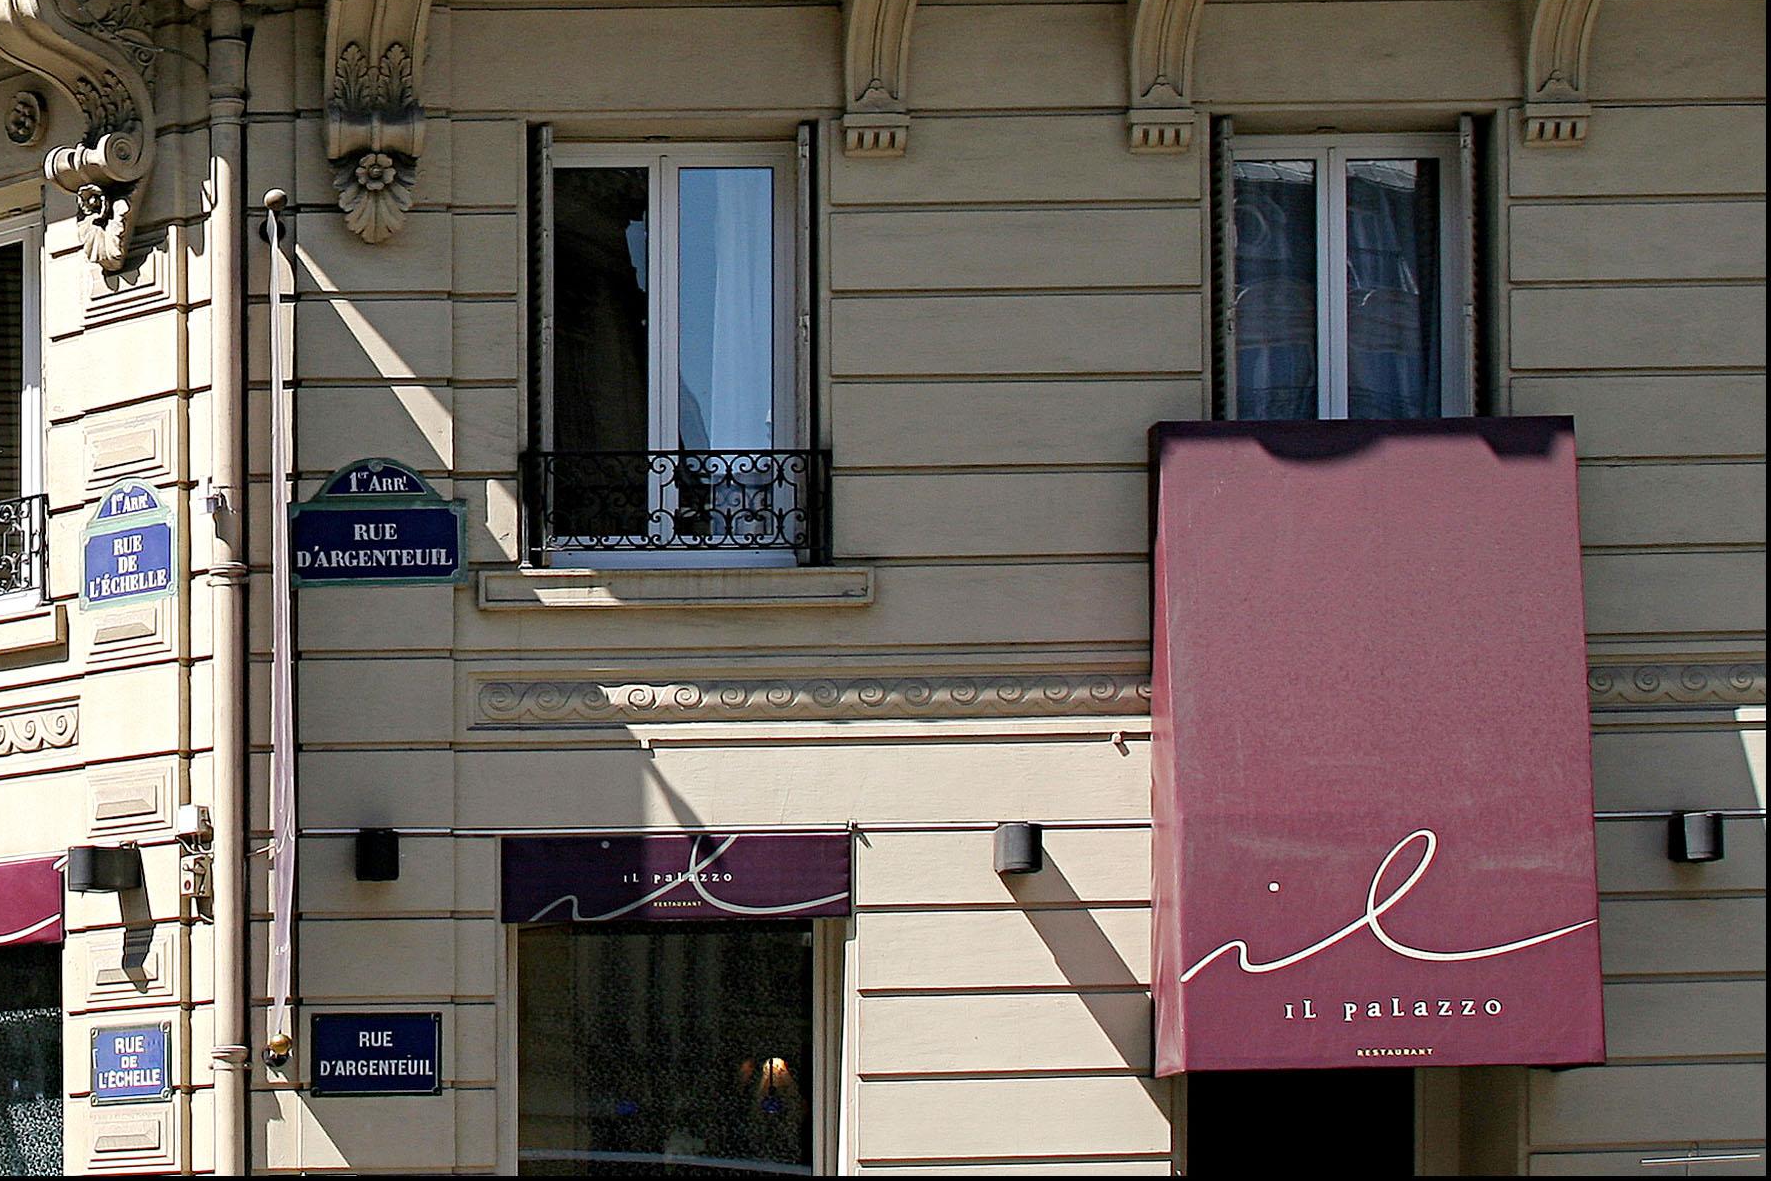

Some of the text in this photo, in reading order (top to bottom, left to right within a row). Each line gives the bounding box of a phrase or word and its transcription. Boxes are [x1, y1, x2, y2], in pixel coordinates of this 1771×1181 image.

[353, 523, 398, 541] RUE
[113, 534, 143, 556] RUE
[118, 555, 138, 574] DE
[296, 546, 453, 568] D'ARGENTEUIL
[89, 568, 168, 599] L'ÉCHELLE
[115, 1035, 145, 1054] RUE
[359, 1031, 393, 1048] RUE
[1356, 1048, 1434, 1057] RESTAURANT
[121, 1055, 138, 1069] DE
[320, 1059, 434, 1076] D'ARGENTEUIL
